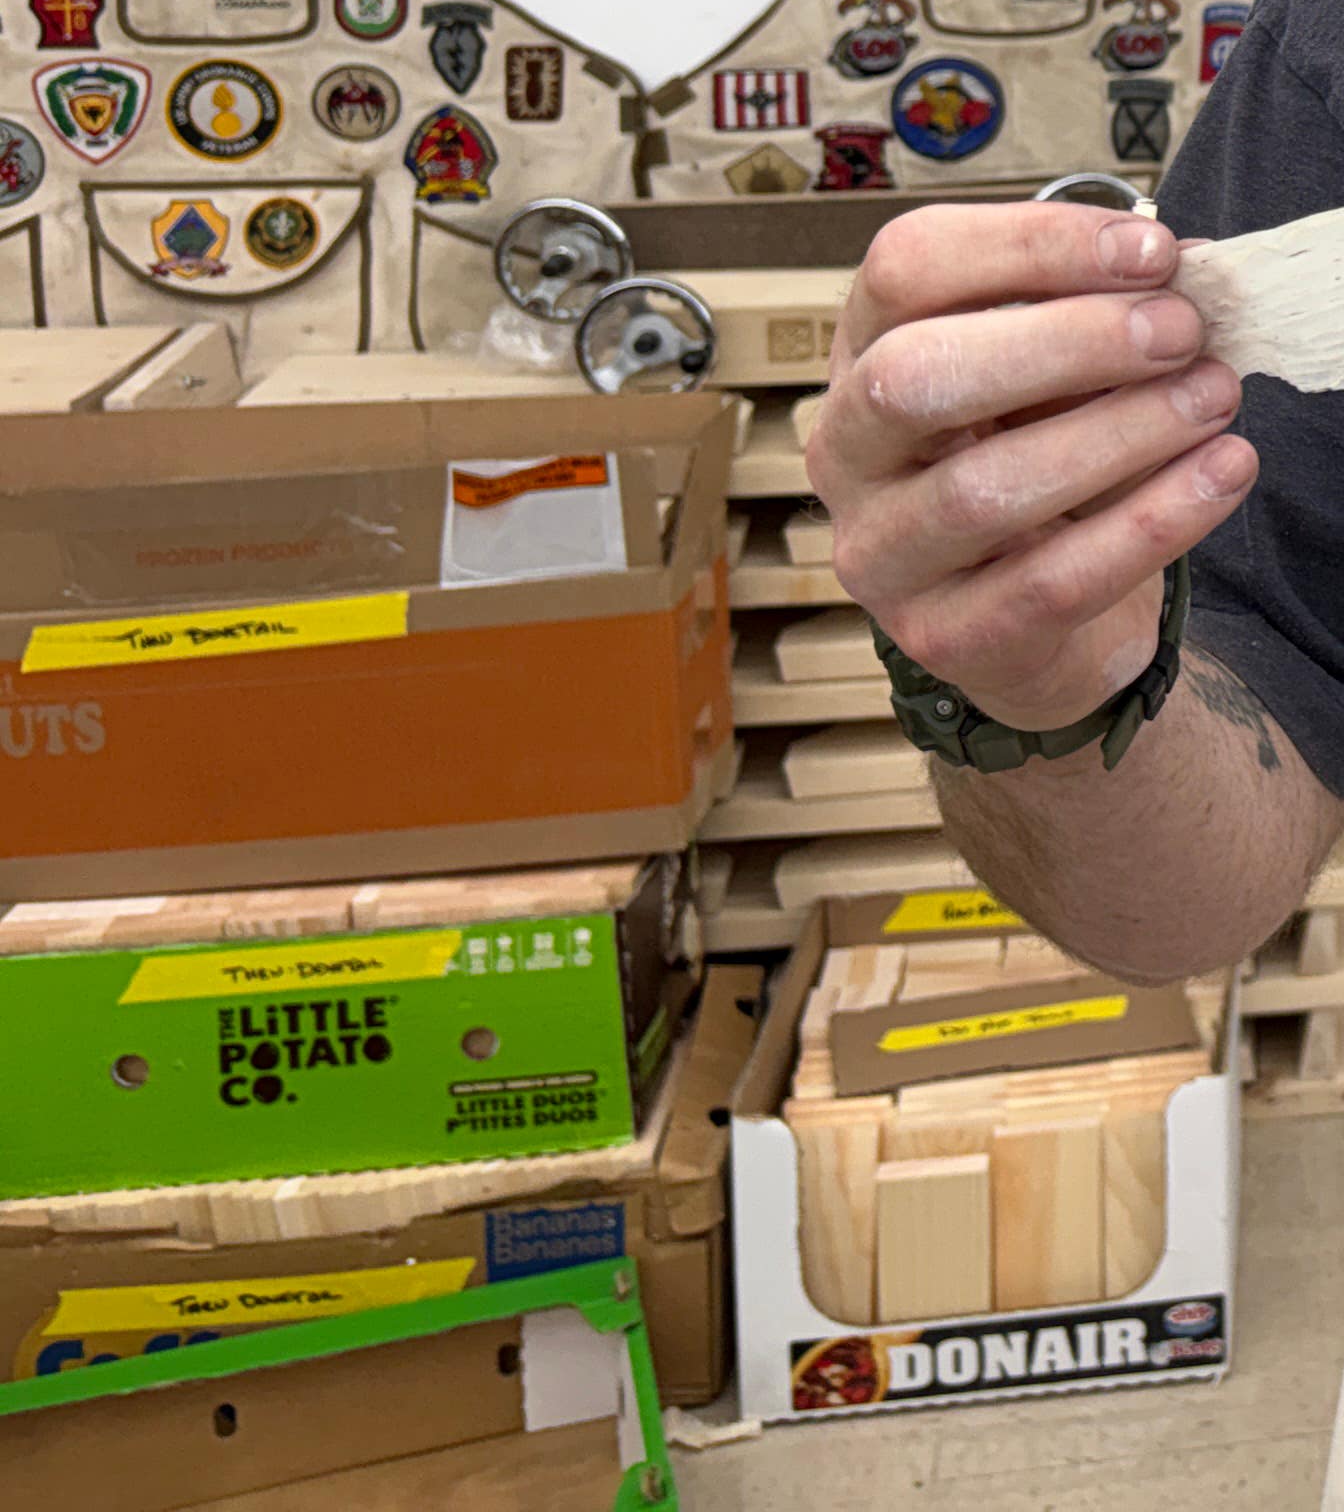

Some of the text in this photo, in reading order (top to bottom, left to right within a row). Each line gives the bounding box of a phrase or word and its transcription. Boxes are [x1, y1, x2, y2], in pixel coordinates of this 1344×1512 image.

[218, 1007, 235, 1040] THE
[219, 1033, 393, 1075] POTATO
[219, 1074, 299, 1108] CO.
[456, 1090, 597, 1115] LITTLE DUOS
[446, 1107, 597, 1133] P'TITES DUOS
[494, 1209, 617, 1238] Bananas
[494, 1233, 616, 1265] Bananes
[887, 1317, 1150, 1392] DONAIR
